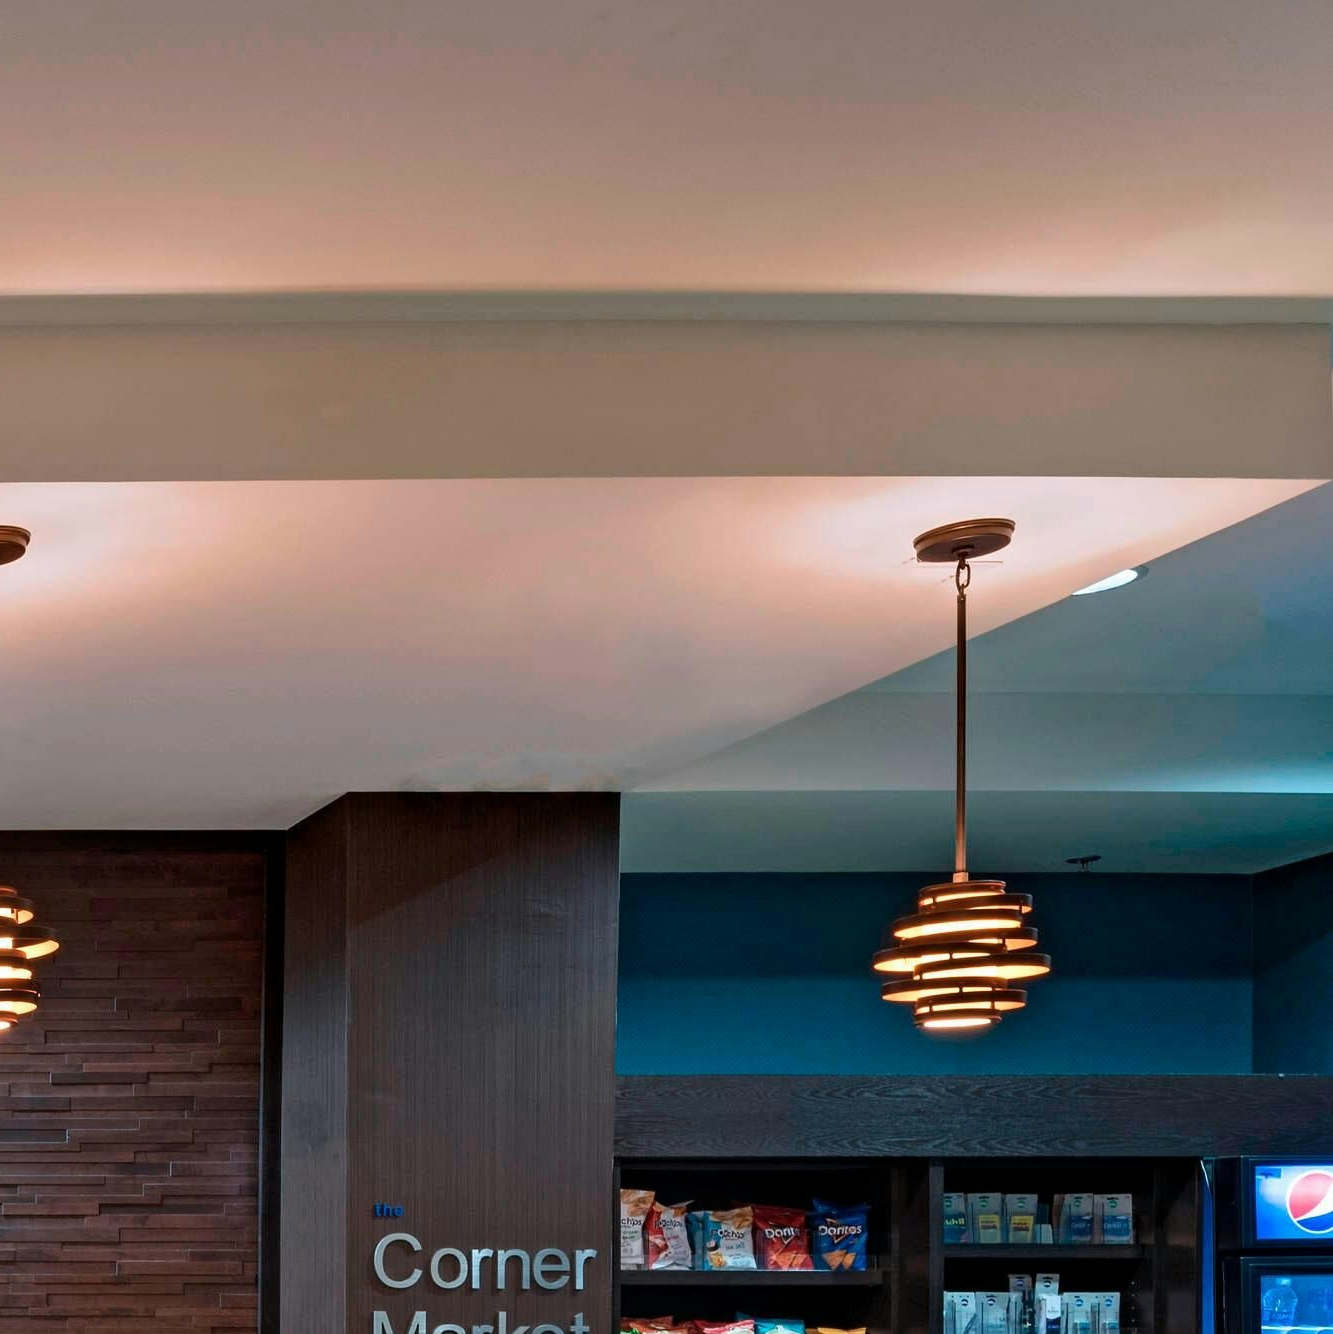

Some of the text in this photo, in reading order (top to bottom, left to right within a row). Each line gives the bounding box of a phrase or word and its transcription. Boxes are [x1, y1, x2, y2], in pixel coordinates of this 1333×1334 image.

[374, 1202, 404, 1217] the
[818, 1225, 862, 1236] Doritos
[374, 1232, 597, 1289] Corner
